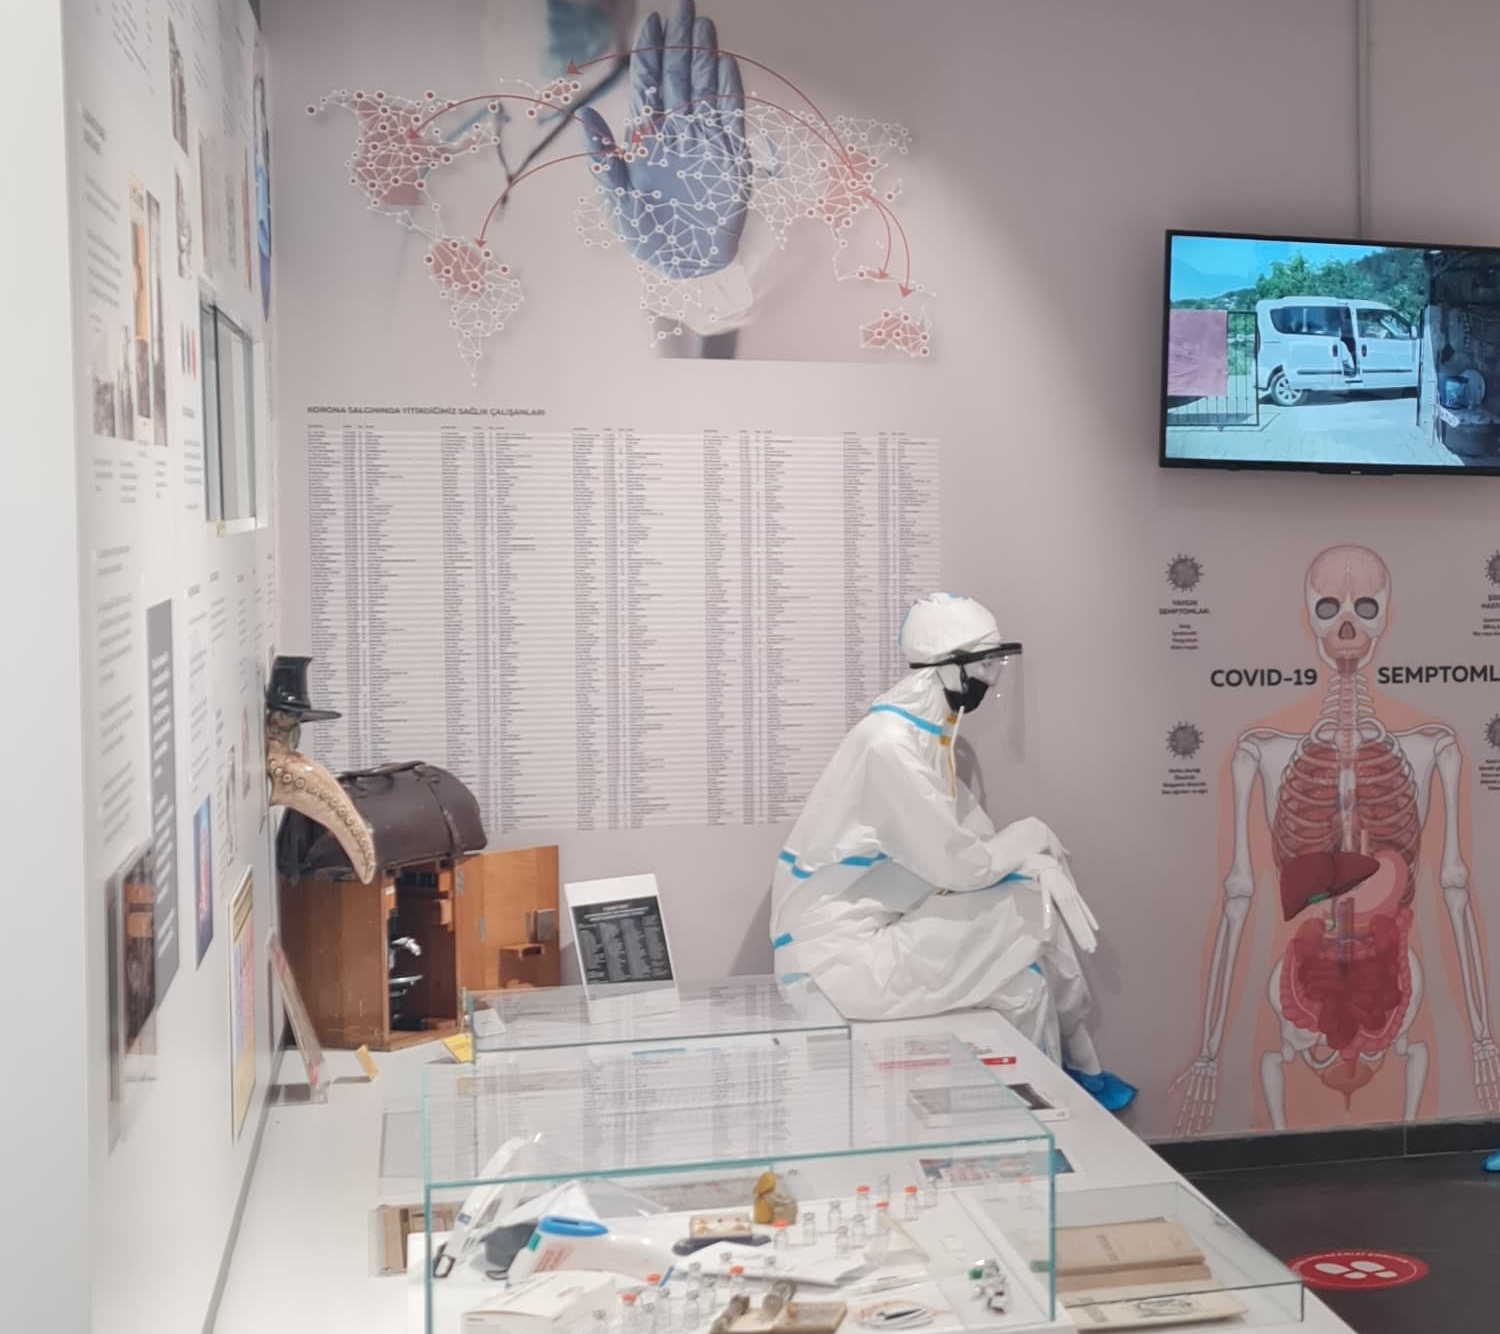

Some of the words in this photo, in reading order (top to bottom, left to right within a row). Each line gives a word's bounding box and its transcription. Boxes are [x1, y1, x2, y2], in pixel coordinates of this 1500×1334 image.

[307, 406, 346, 415] KORONA
[347, 406, 401, 416] SALGININDA
[458, 407, 488, 417] SAĞLIK
[489, 408, 546, 418] ÇALIŞANLARI
[1210, 667, 1318, 688] COVID-19
